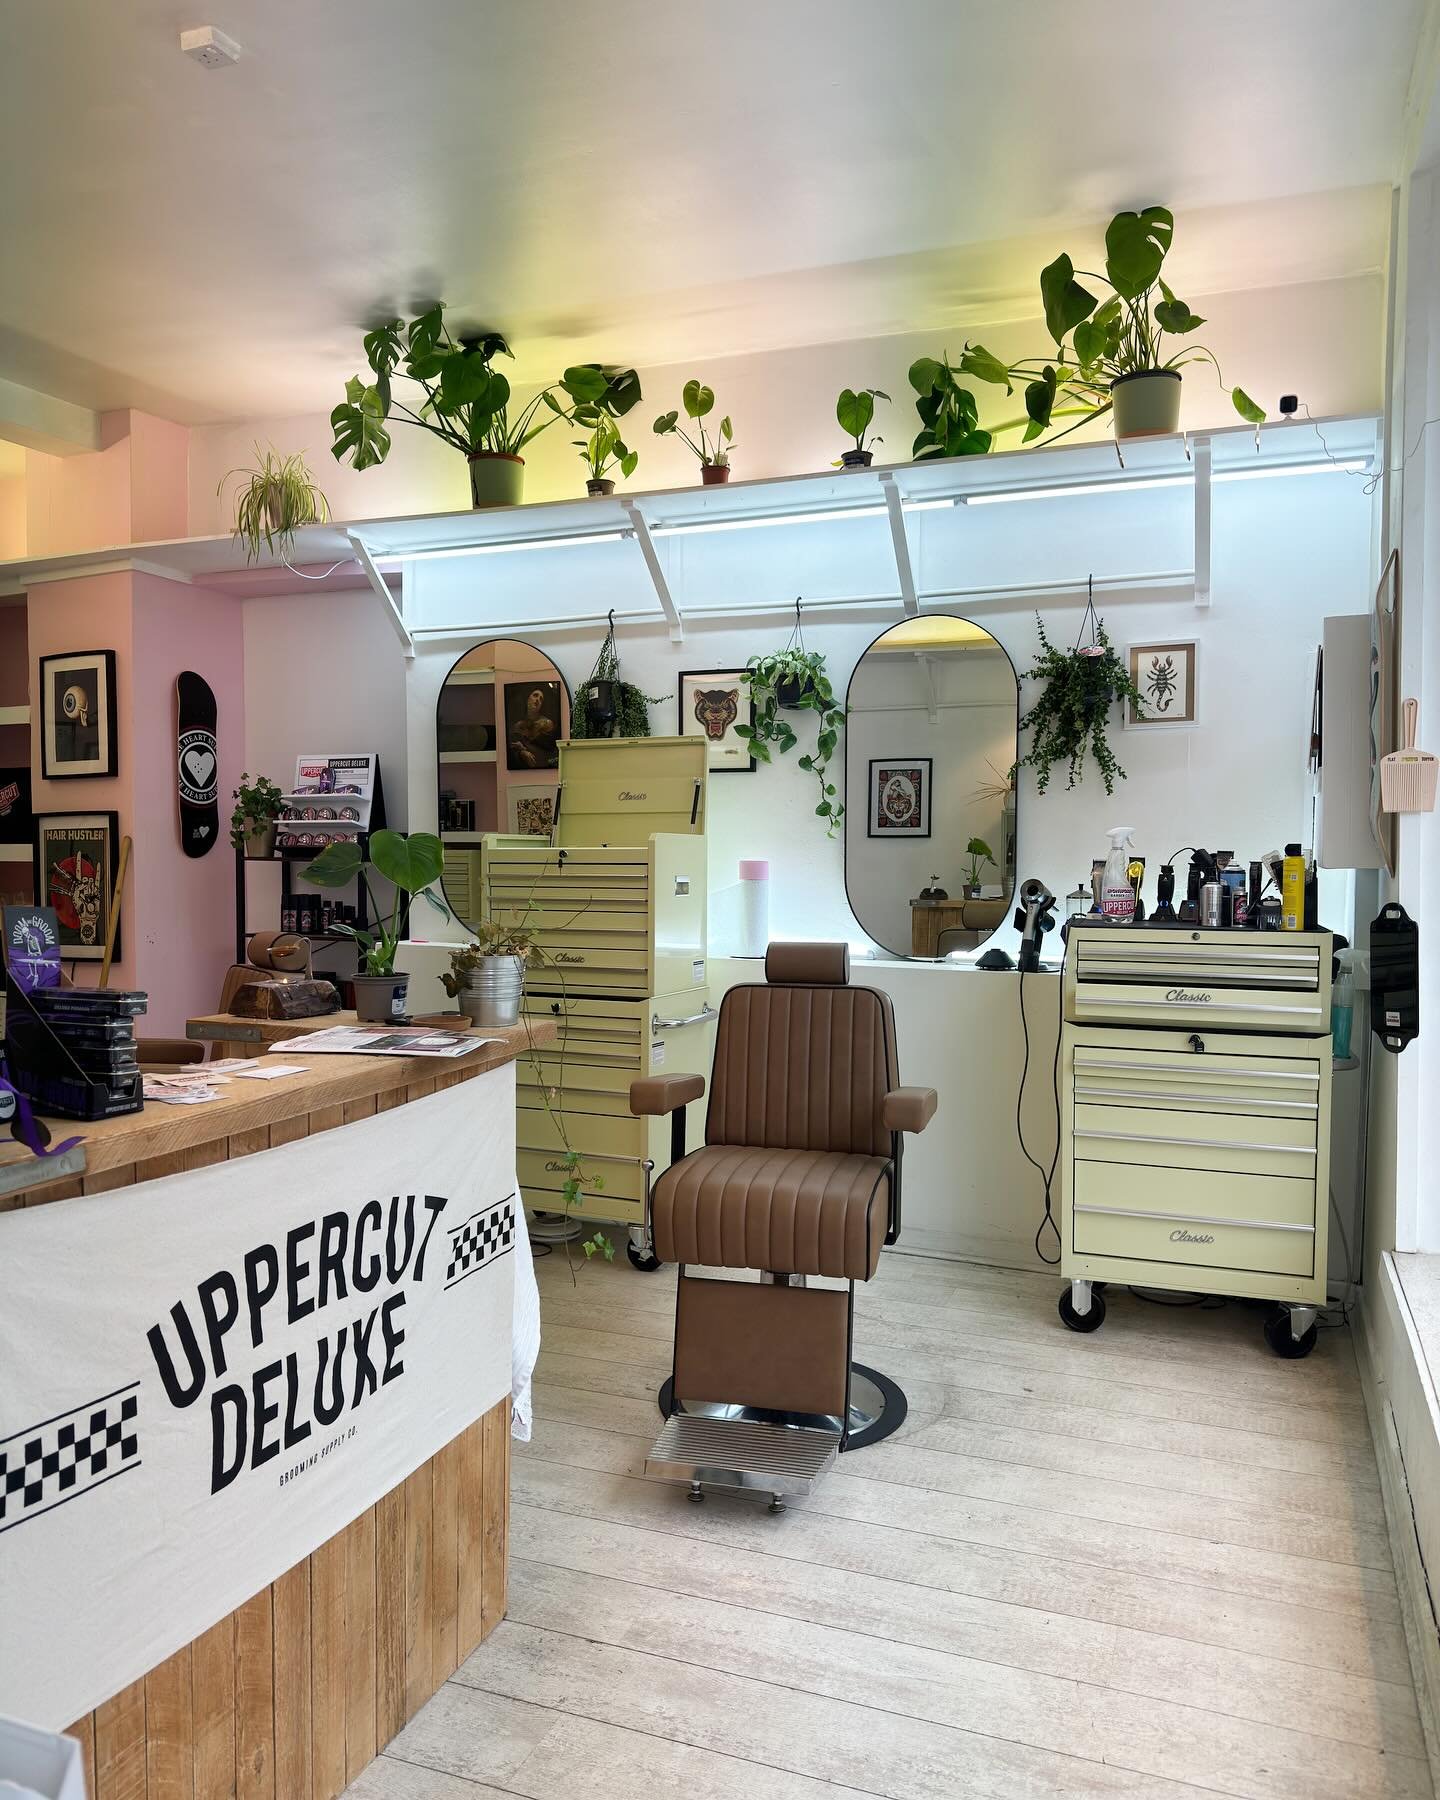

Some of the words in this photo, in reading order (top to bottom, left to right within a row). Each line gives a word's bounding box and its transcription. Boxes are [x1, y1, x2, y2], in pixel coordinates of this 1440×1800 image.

[184, 734, 207, 746] HEART
[330, 760, 350, 768] UPPERCUT
[351, 759, 367, 768] DELUXE
[0, 782, 18, 804] RCUT
[184, 787, 207, 800] HEART
[617, 791, 648, 802] Classic
[46, 830, 66, 841] HAIR
[68, 829, 104, 841] HUSTLER
[32, 915, 56, 945] GROOM
[555, 952, 585, 964] Classic
[1166, 988, 1213, 1002] Classic
[1169, 1229, 1215, 1244] Classic
[147, 1195, 449, 1409] UPPERCUT
[210, 1290, 407, 1496] DELUXE
[279, 1452, 318, 1487] GROOMING
[321, 1433, 345, 1459] SUPPLY
[347, 1425, 358, 1440] CO.
